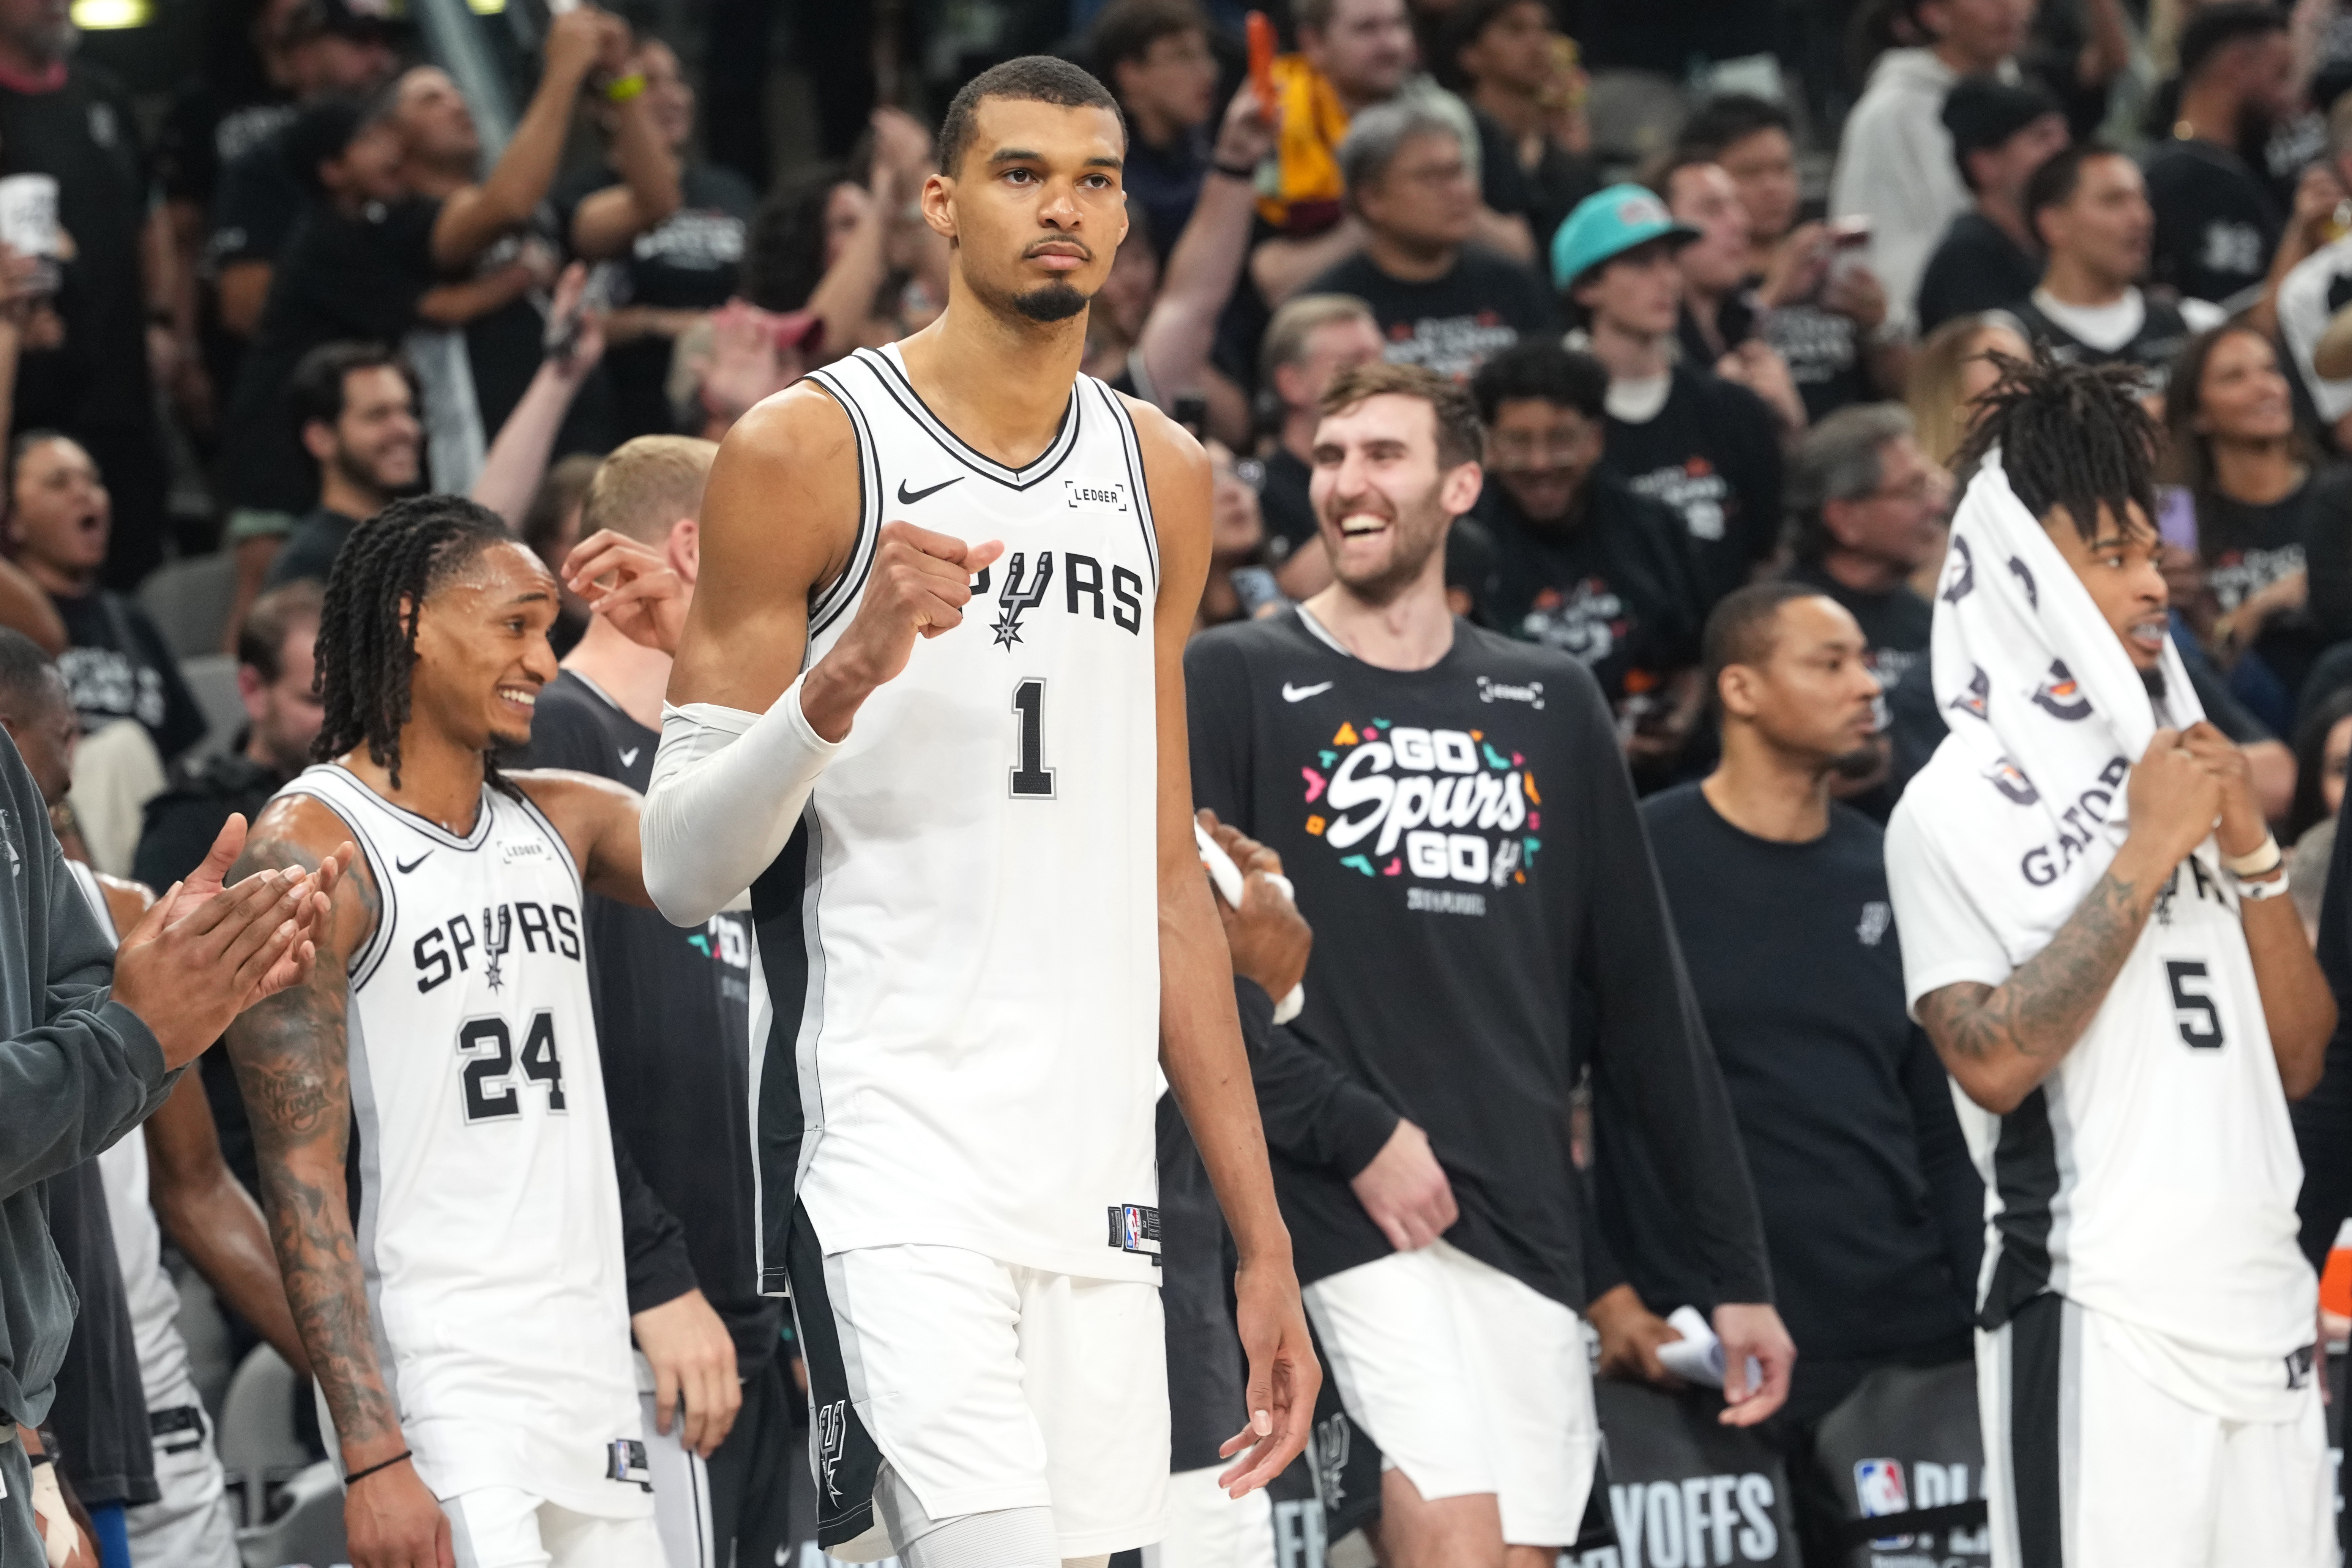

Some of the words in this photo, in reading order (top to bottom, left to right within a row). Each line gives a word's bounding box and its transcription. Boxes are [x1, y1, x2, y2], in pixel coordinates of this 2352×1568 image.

[1074, 489, 1117, 503] LEDGER
[961, 551, 1142, 653] URS
[1009, 677, 1057, 800] 1
[1390, 727, 1480, 774] GO
[1327, 740, 1525, 857] Spurs
[2022, 756, 2131, 886] GATOR
[1407, 830, 1489, 883] GO
[413, 902, 581, 995] SPURS
[2164, 958, 2225, 1051] 5
[456, 1007, 568, 1126] 24
[1609, 1472, 1778, 1568] YOFFS
